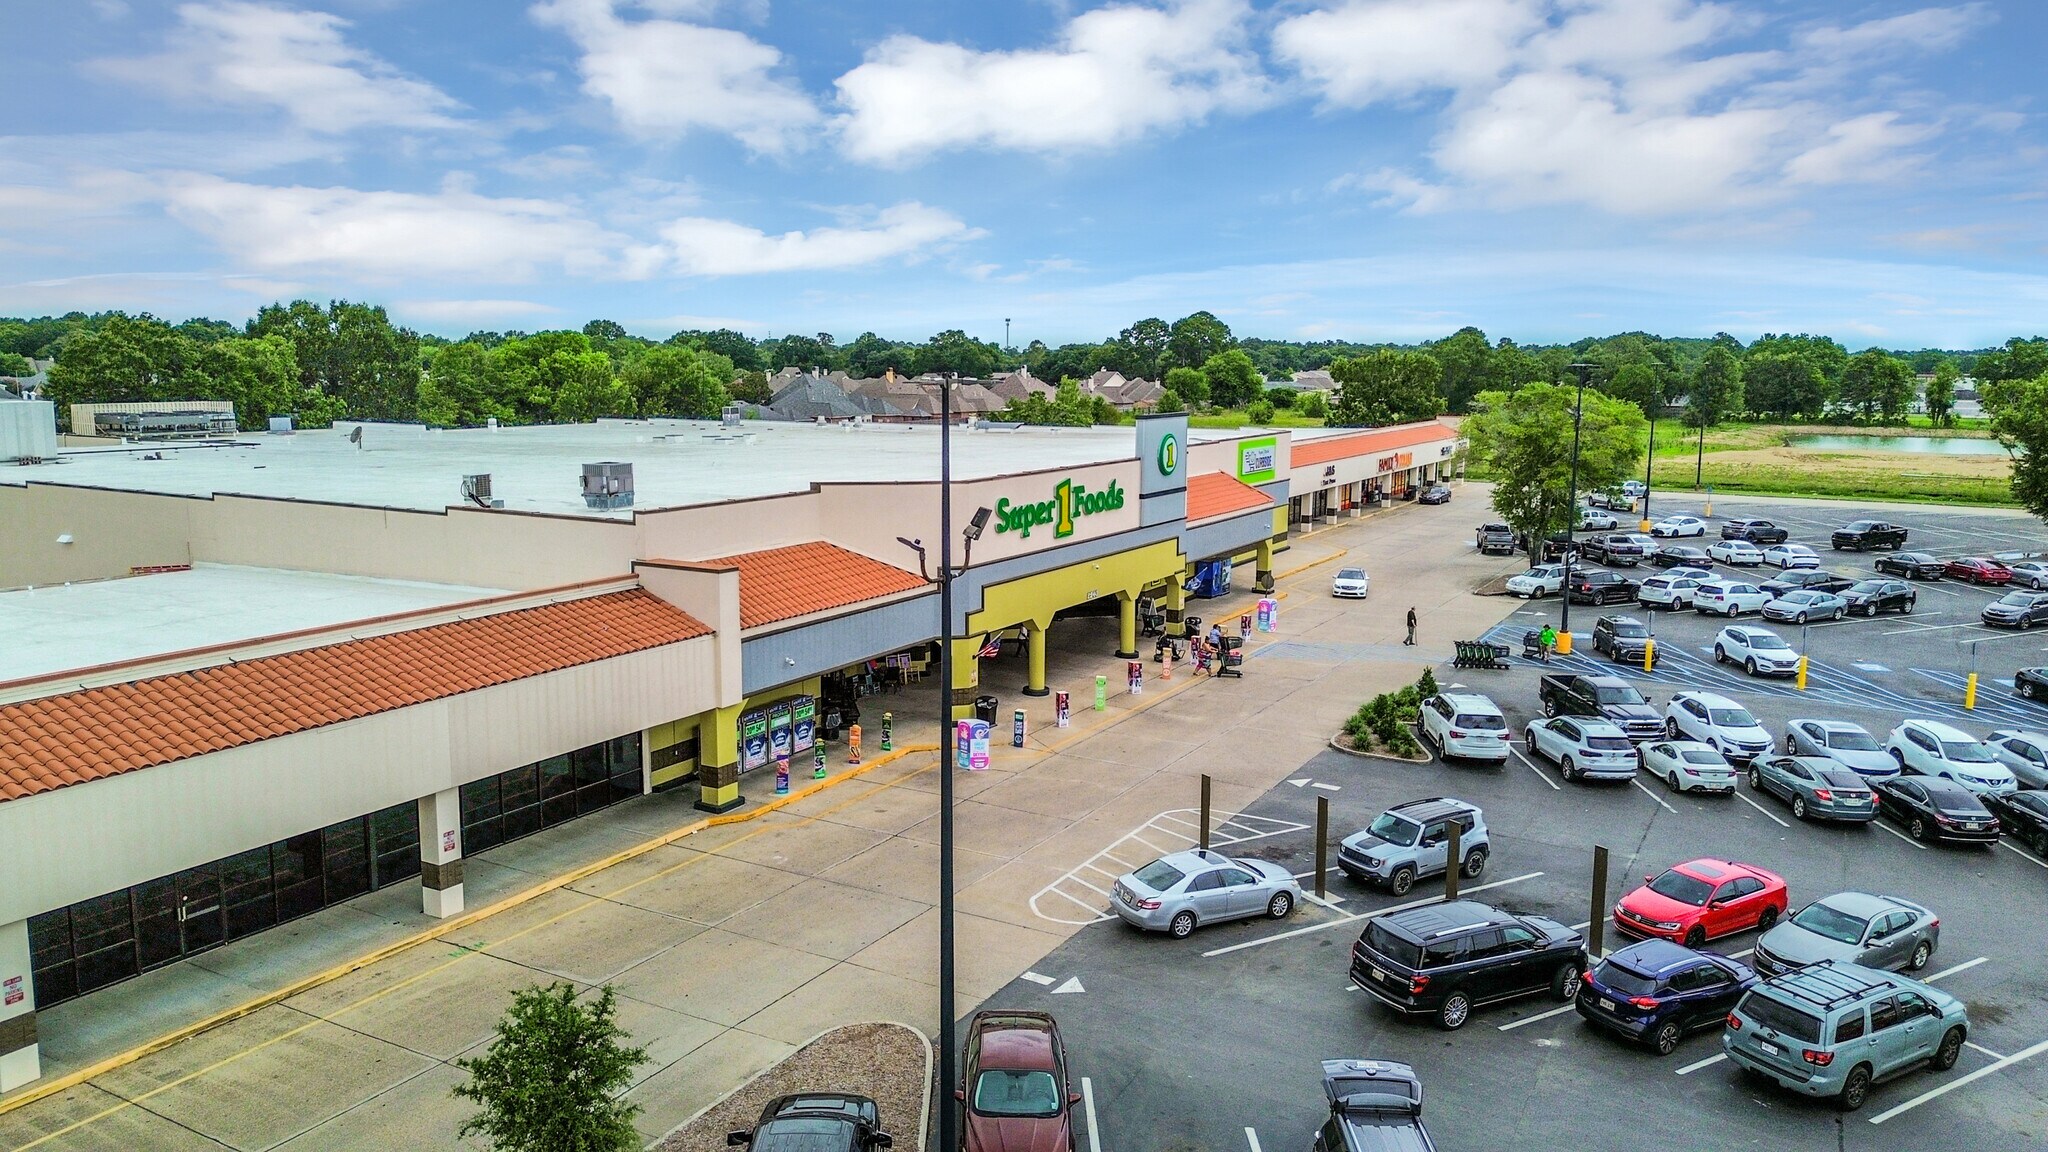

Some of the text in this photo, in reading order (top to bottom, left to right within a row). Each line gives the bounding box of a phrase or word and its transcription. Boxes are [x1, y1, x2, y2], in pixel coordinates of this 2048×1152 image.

[1166, 442, 1175, 468] 1
[994, 477, 1124, 539] Super 1 Foods
